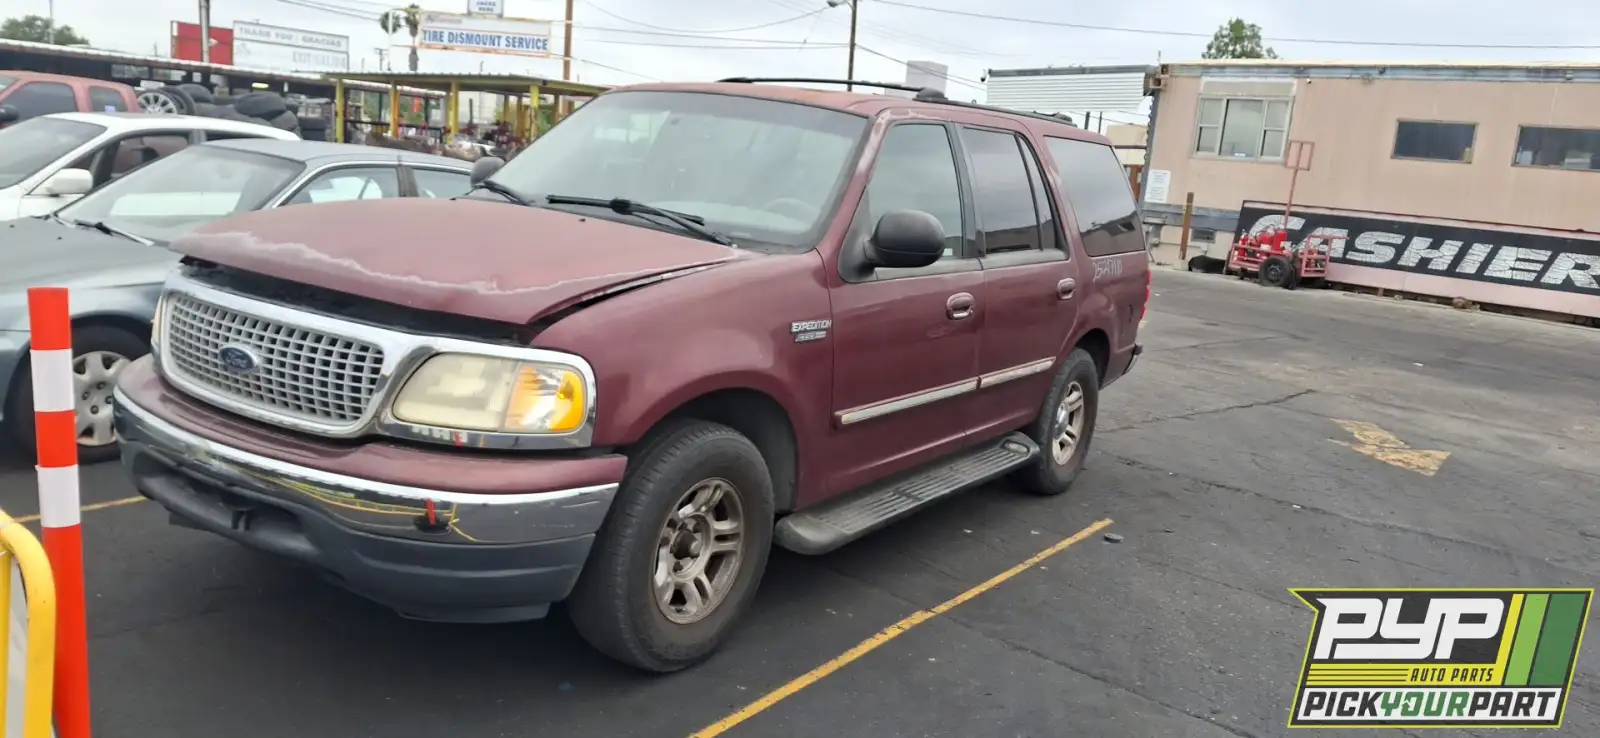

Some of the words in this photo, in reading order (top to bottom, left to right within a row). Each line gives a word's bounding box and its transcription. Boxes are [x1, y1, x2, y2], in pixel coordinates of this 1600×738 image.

[239, 26, 271, 38] THANK
[275, 32, 293, 40] YOU
[301, 35, 342, 47] GRACIAS
[422, 29, 445, 43] TIRE
[448, 31, 503, 47] DISMOUNT
[505, 35, 548, 50] SERVICE
[1246, 214, 1600, 289] CASHIER
[791, 319, 832, 333] EXPEDITION
